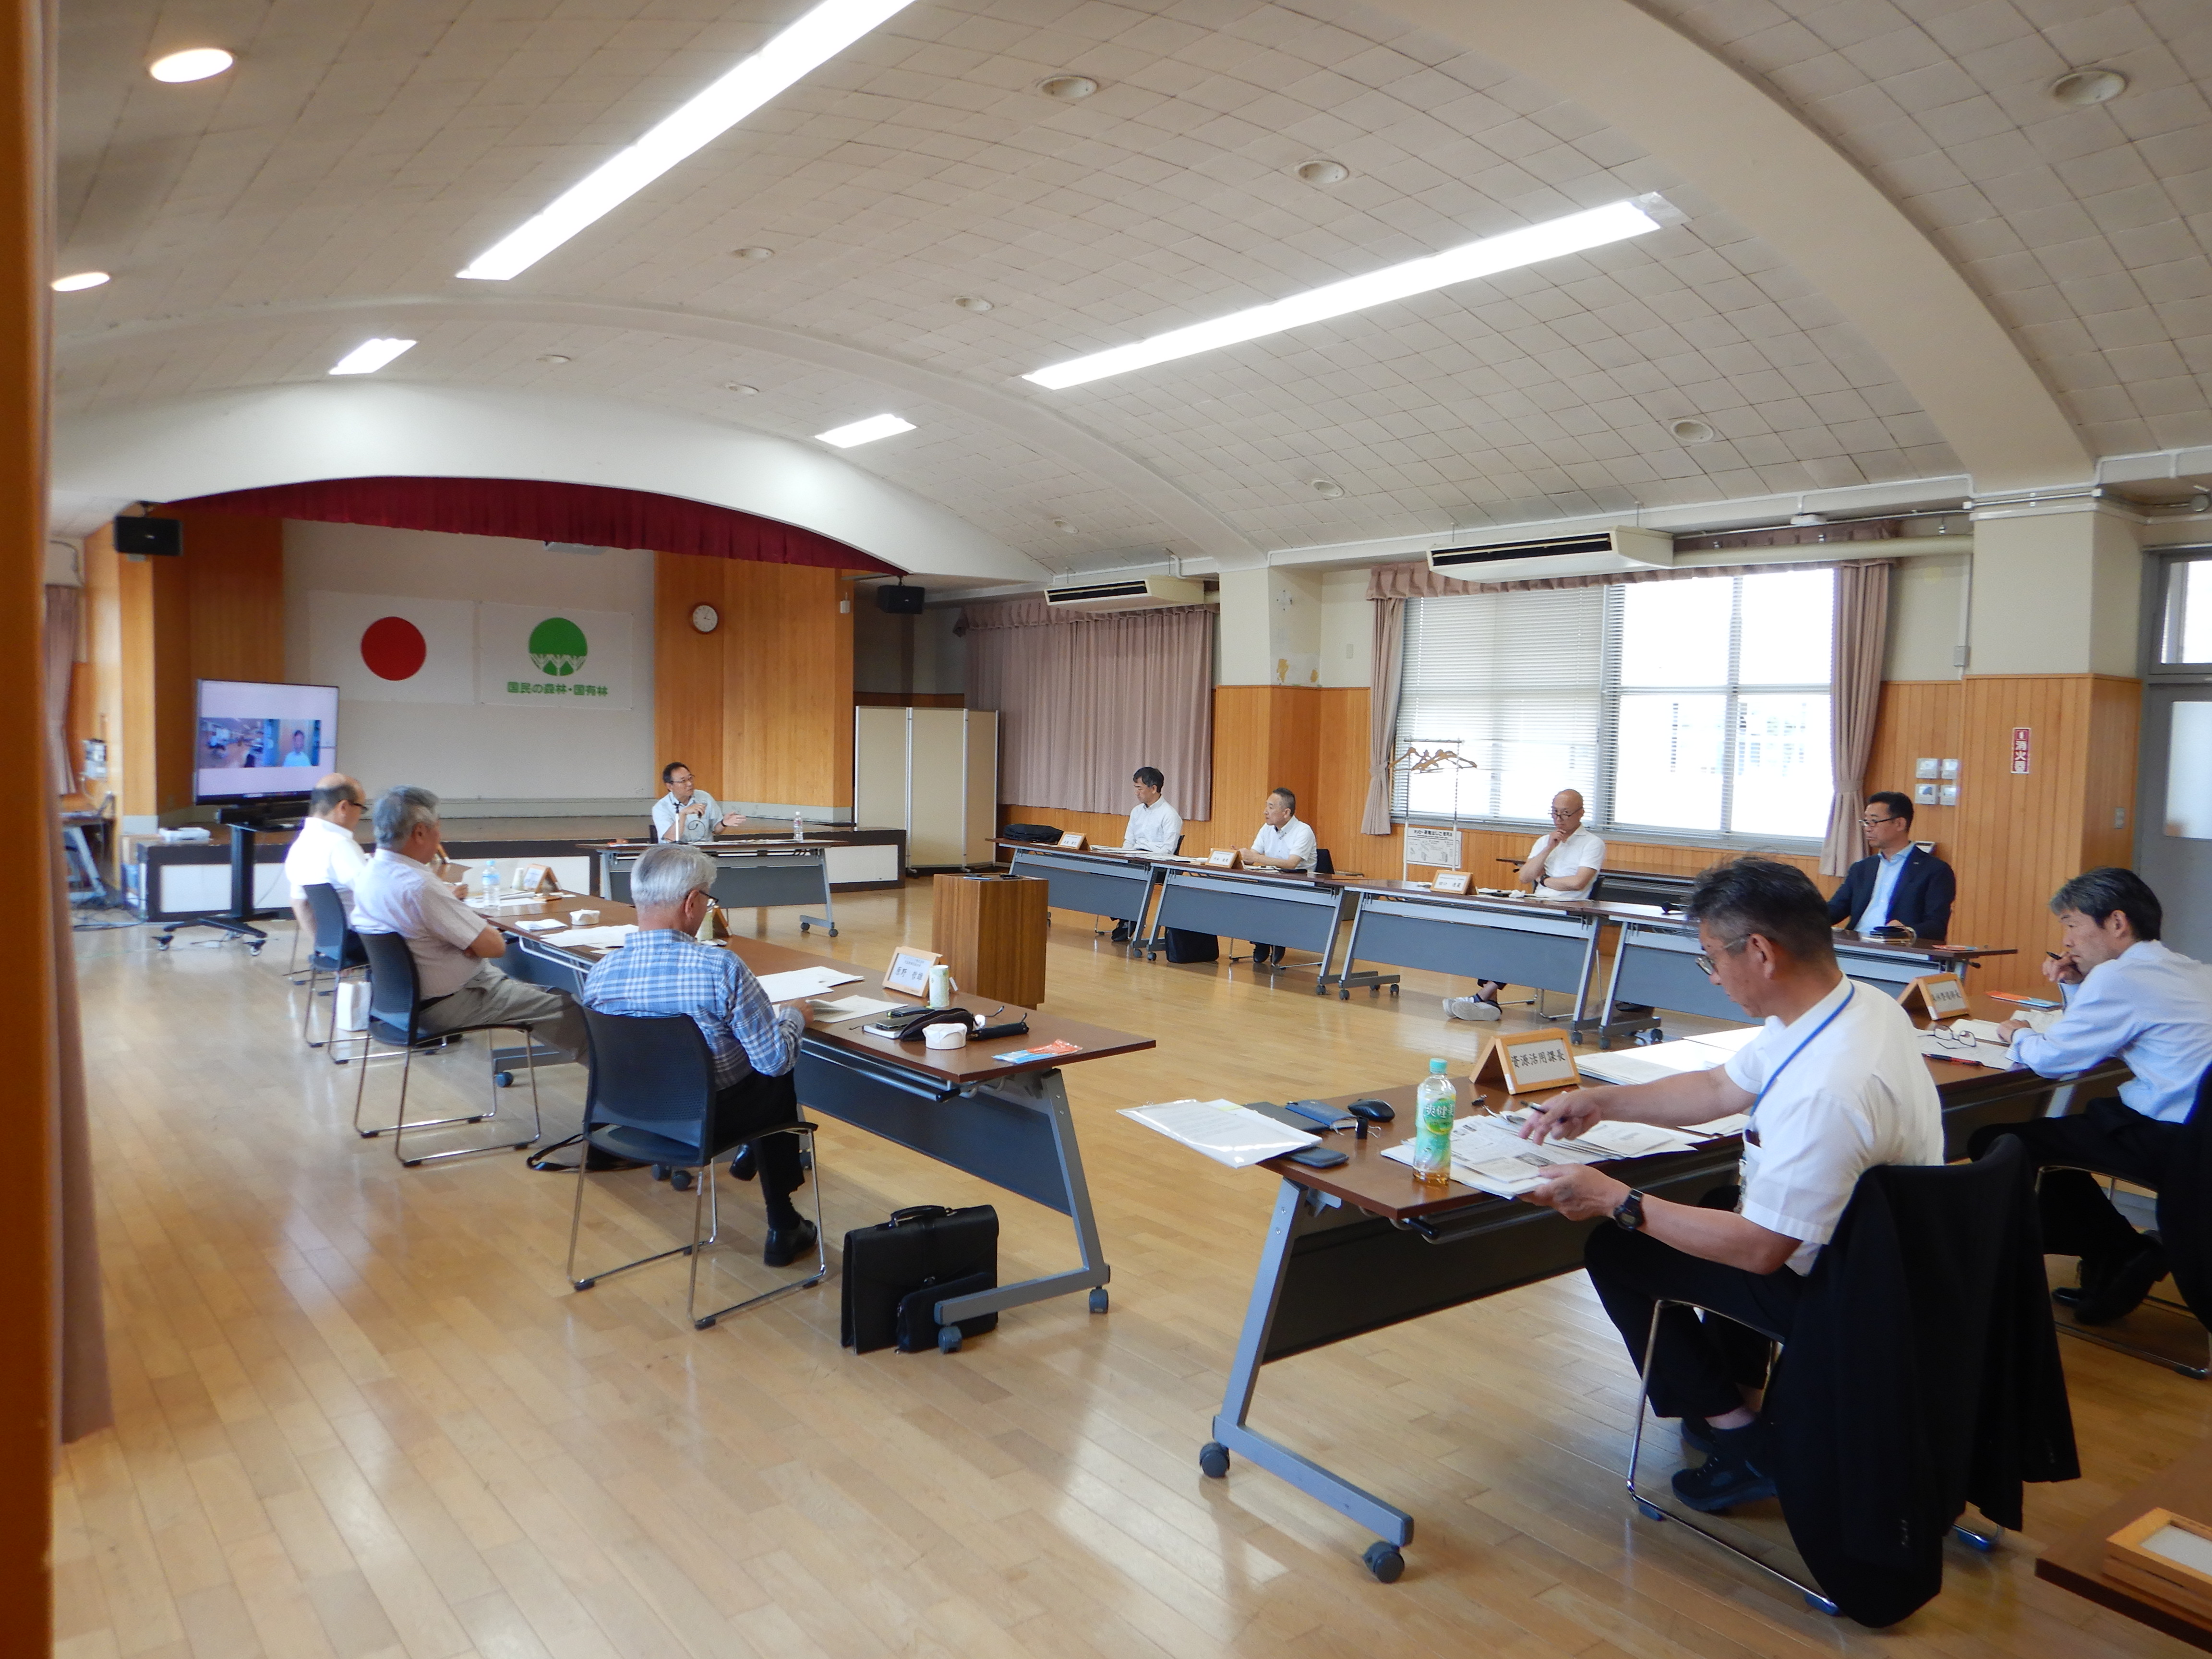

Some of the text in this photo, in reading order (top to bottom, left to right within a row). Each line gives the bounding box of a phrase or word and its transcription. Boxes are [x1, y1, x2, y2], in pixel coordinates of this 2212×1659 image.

[507, 682, 608, 696] 国民の森林・国有林
[2015, 740, 2027, 772] 消火器
[1511, 1049, 1565, 1068] 資源活用課長
